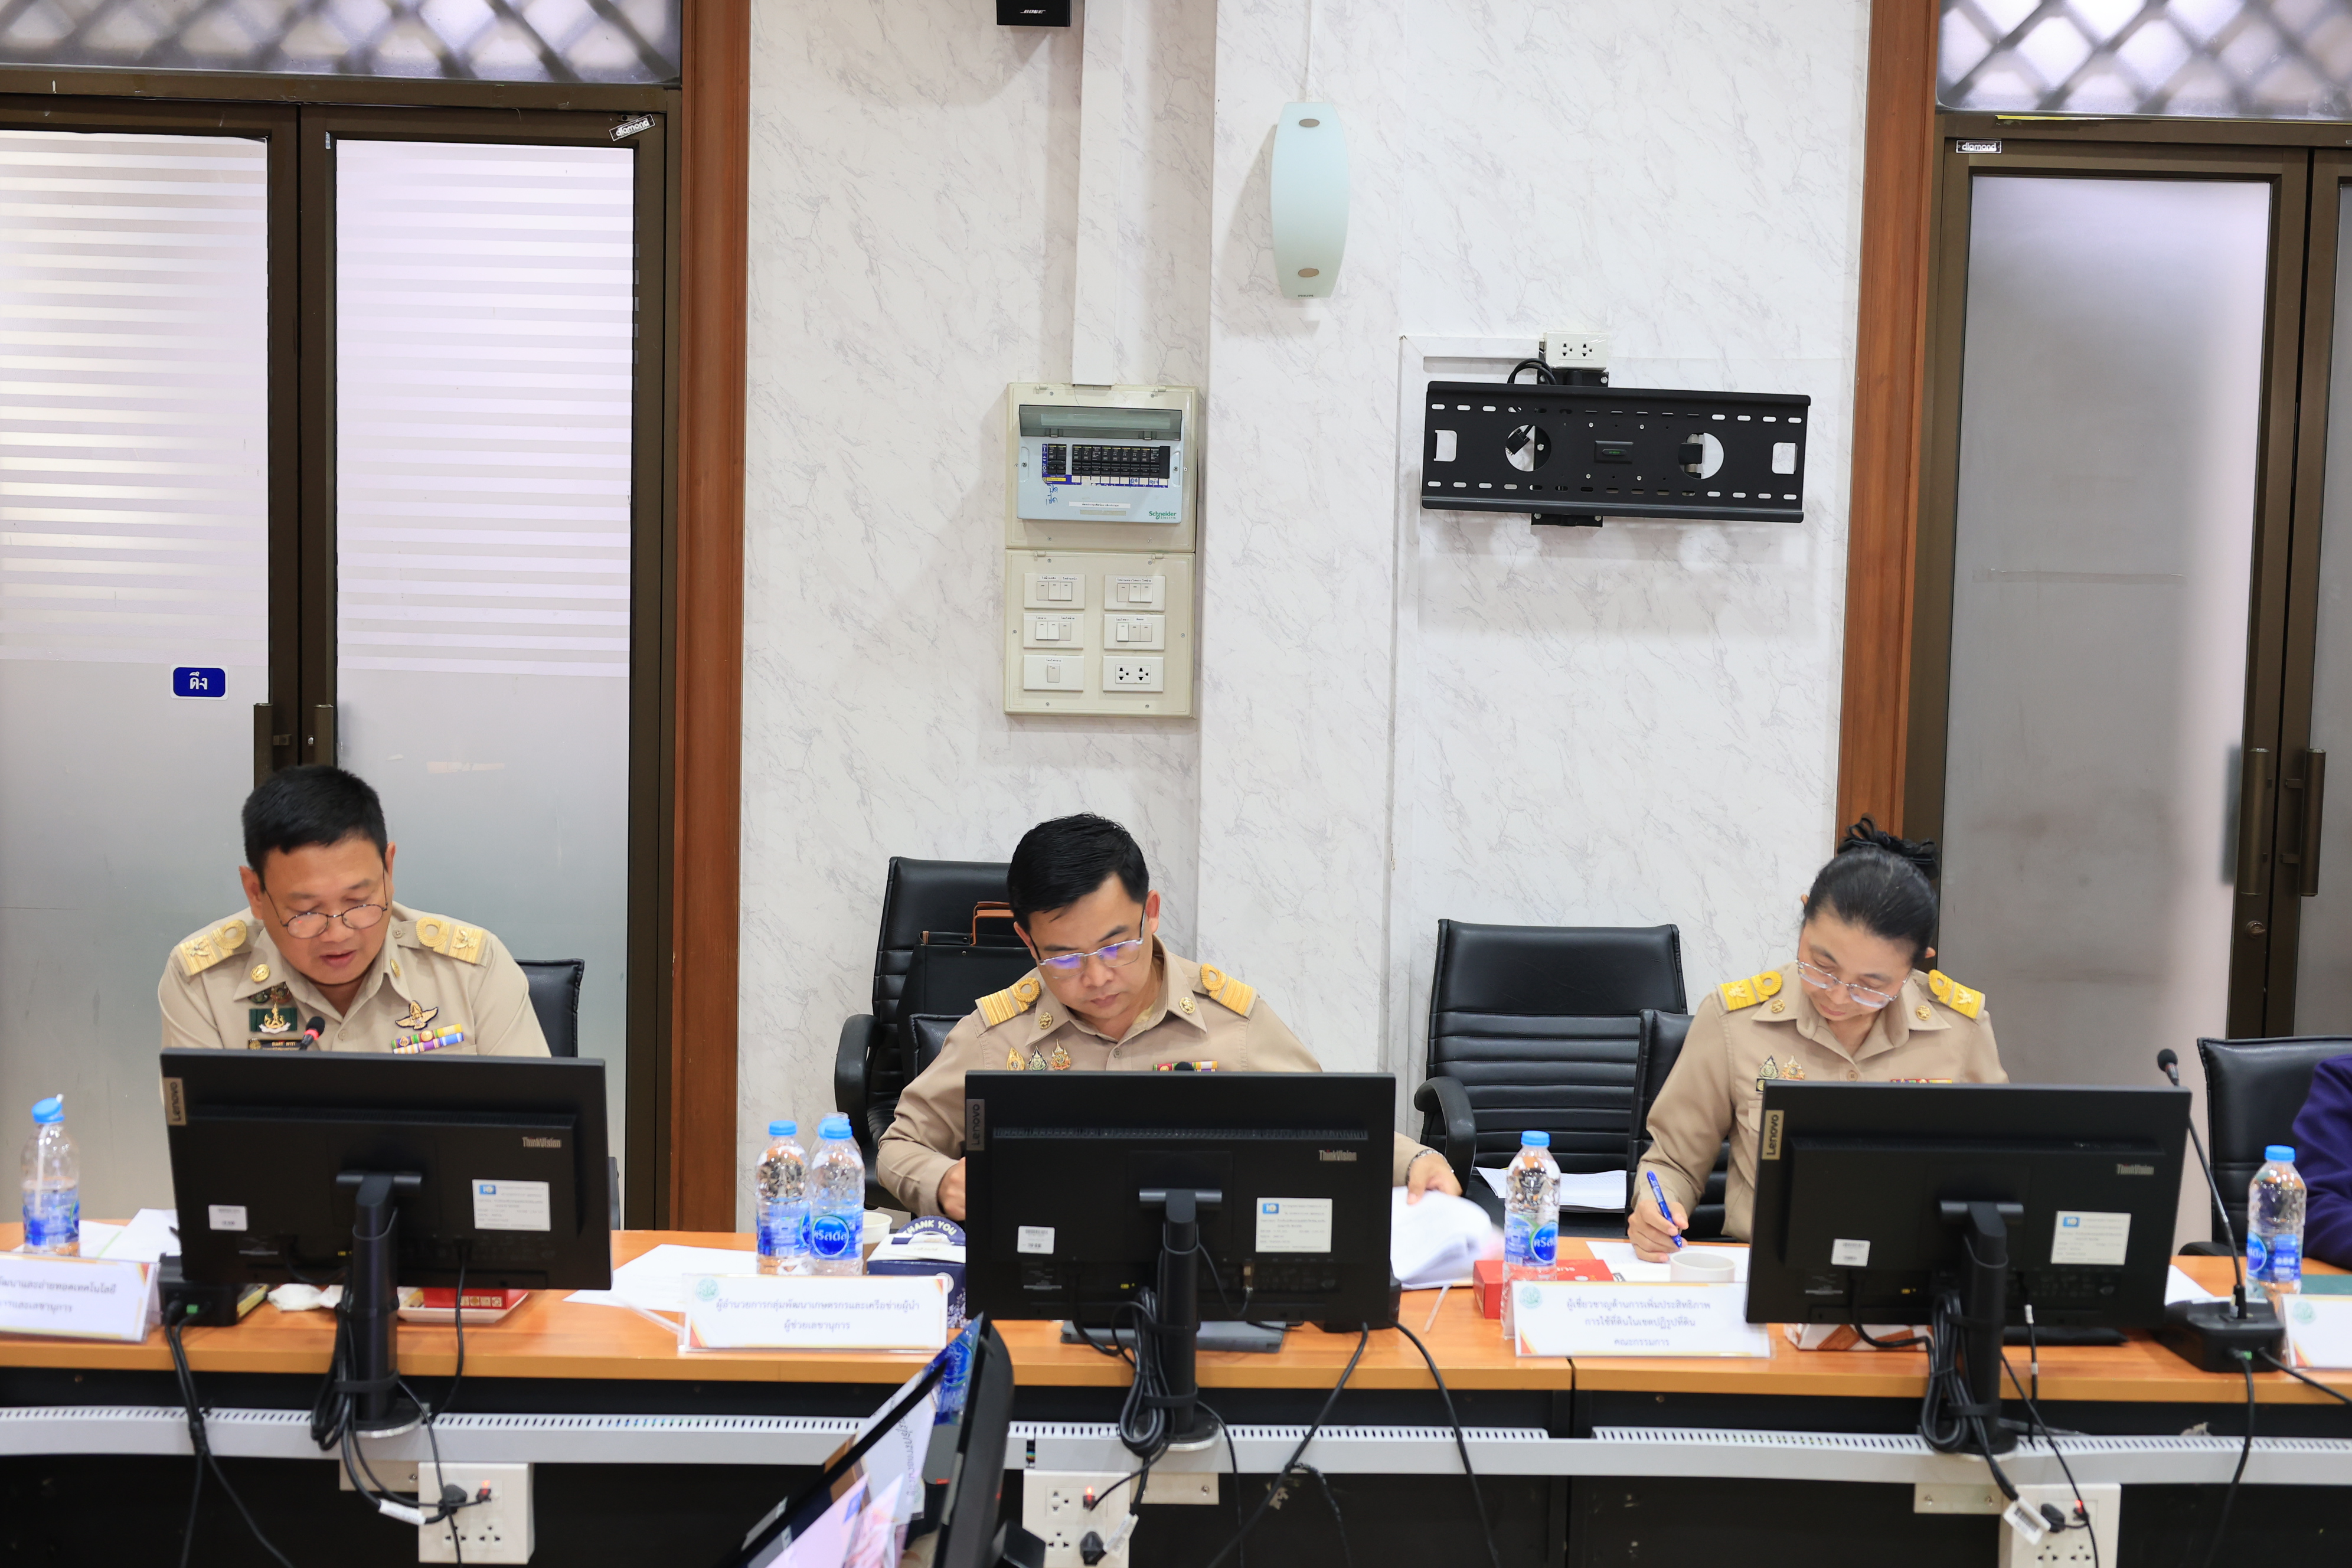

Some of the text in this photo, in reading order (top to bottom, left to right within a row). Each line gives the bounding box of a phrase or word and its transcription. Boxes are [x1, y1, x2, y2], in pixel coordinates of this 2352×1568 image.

[1962, 142, 1997, 152] diamond
[190, 671, 208, 690] ดึง
[972, 1104, 980, 1145] Lenovo
[1766, 1114, 1779, 1155] Lenovo
[937, 1220, 957, 1236] YOU
